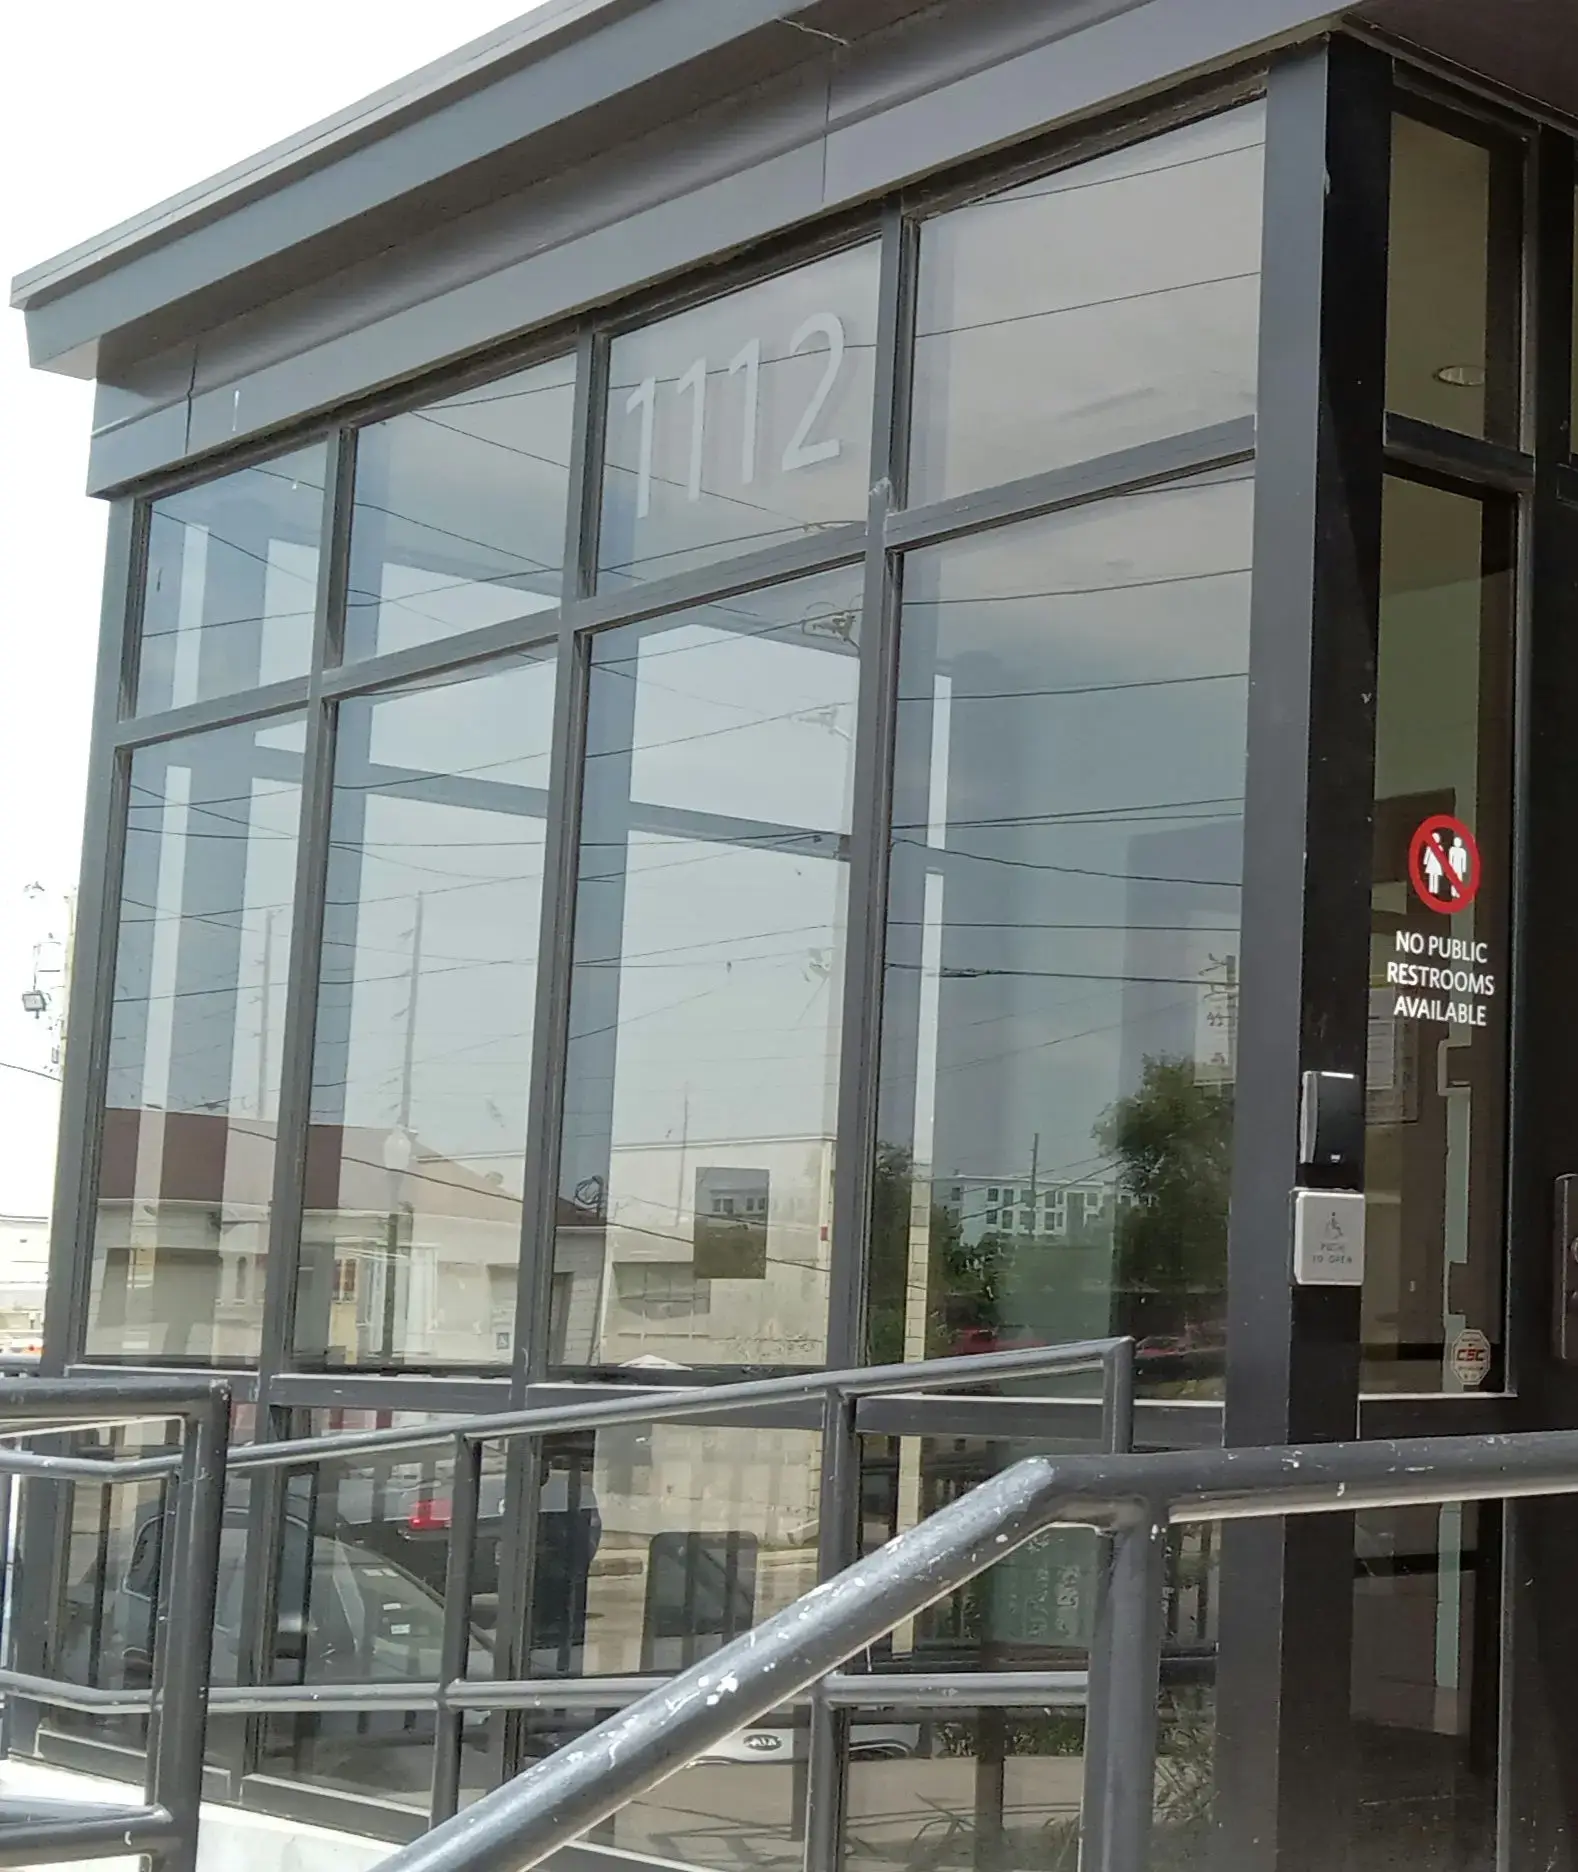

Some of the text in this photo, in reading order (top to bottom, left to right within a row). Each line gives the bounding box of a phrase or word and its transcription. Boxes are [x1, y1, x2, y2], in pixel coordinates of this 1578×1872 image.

[626, 312, 845, 520] 1112
[1396, 930, 1488, 964] NO PUBLIC
[1386, 961, 1495, 996] RESTROOMS
[1393, 994, 1488, 1027] AVAILABLE
